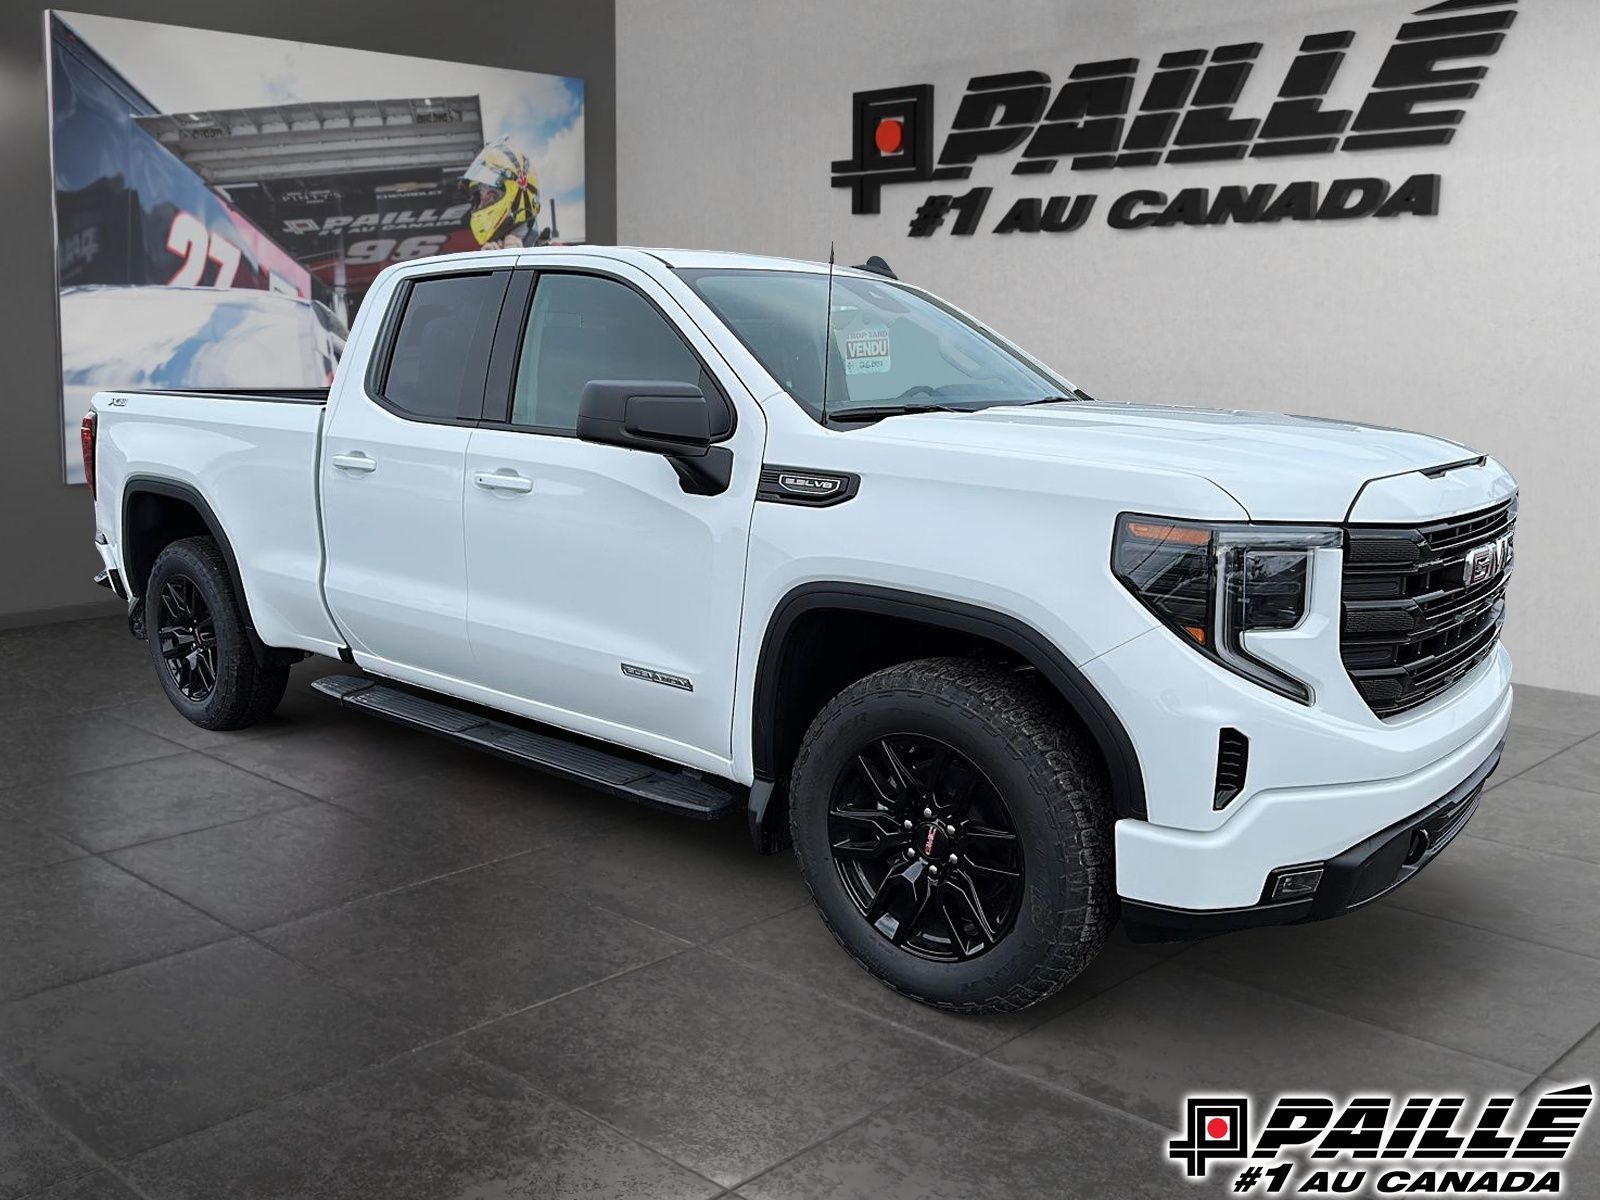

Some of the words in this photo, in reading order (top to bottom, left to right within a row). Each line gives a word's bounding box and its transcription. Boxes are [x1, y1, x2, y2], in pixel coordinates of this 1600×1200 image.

[931, 0, 1519, 182] PAILLÉ
[907, 186, 994, 238] #1
[992, 193, 1098, 237] AU
[1106, 173, 1443, 231] CANADA
[347, 226, 375, 234] AU
[381, 219, 463, 232] CANADA
[344, 234, 449, 266] 96
[848, 340, 887, 357] VENDU
